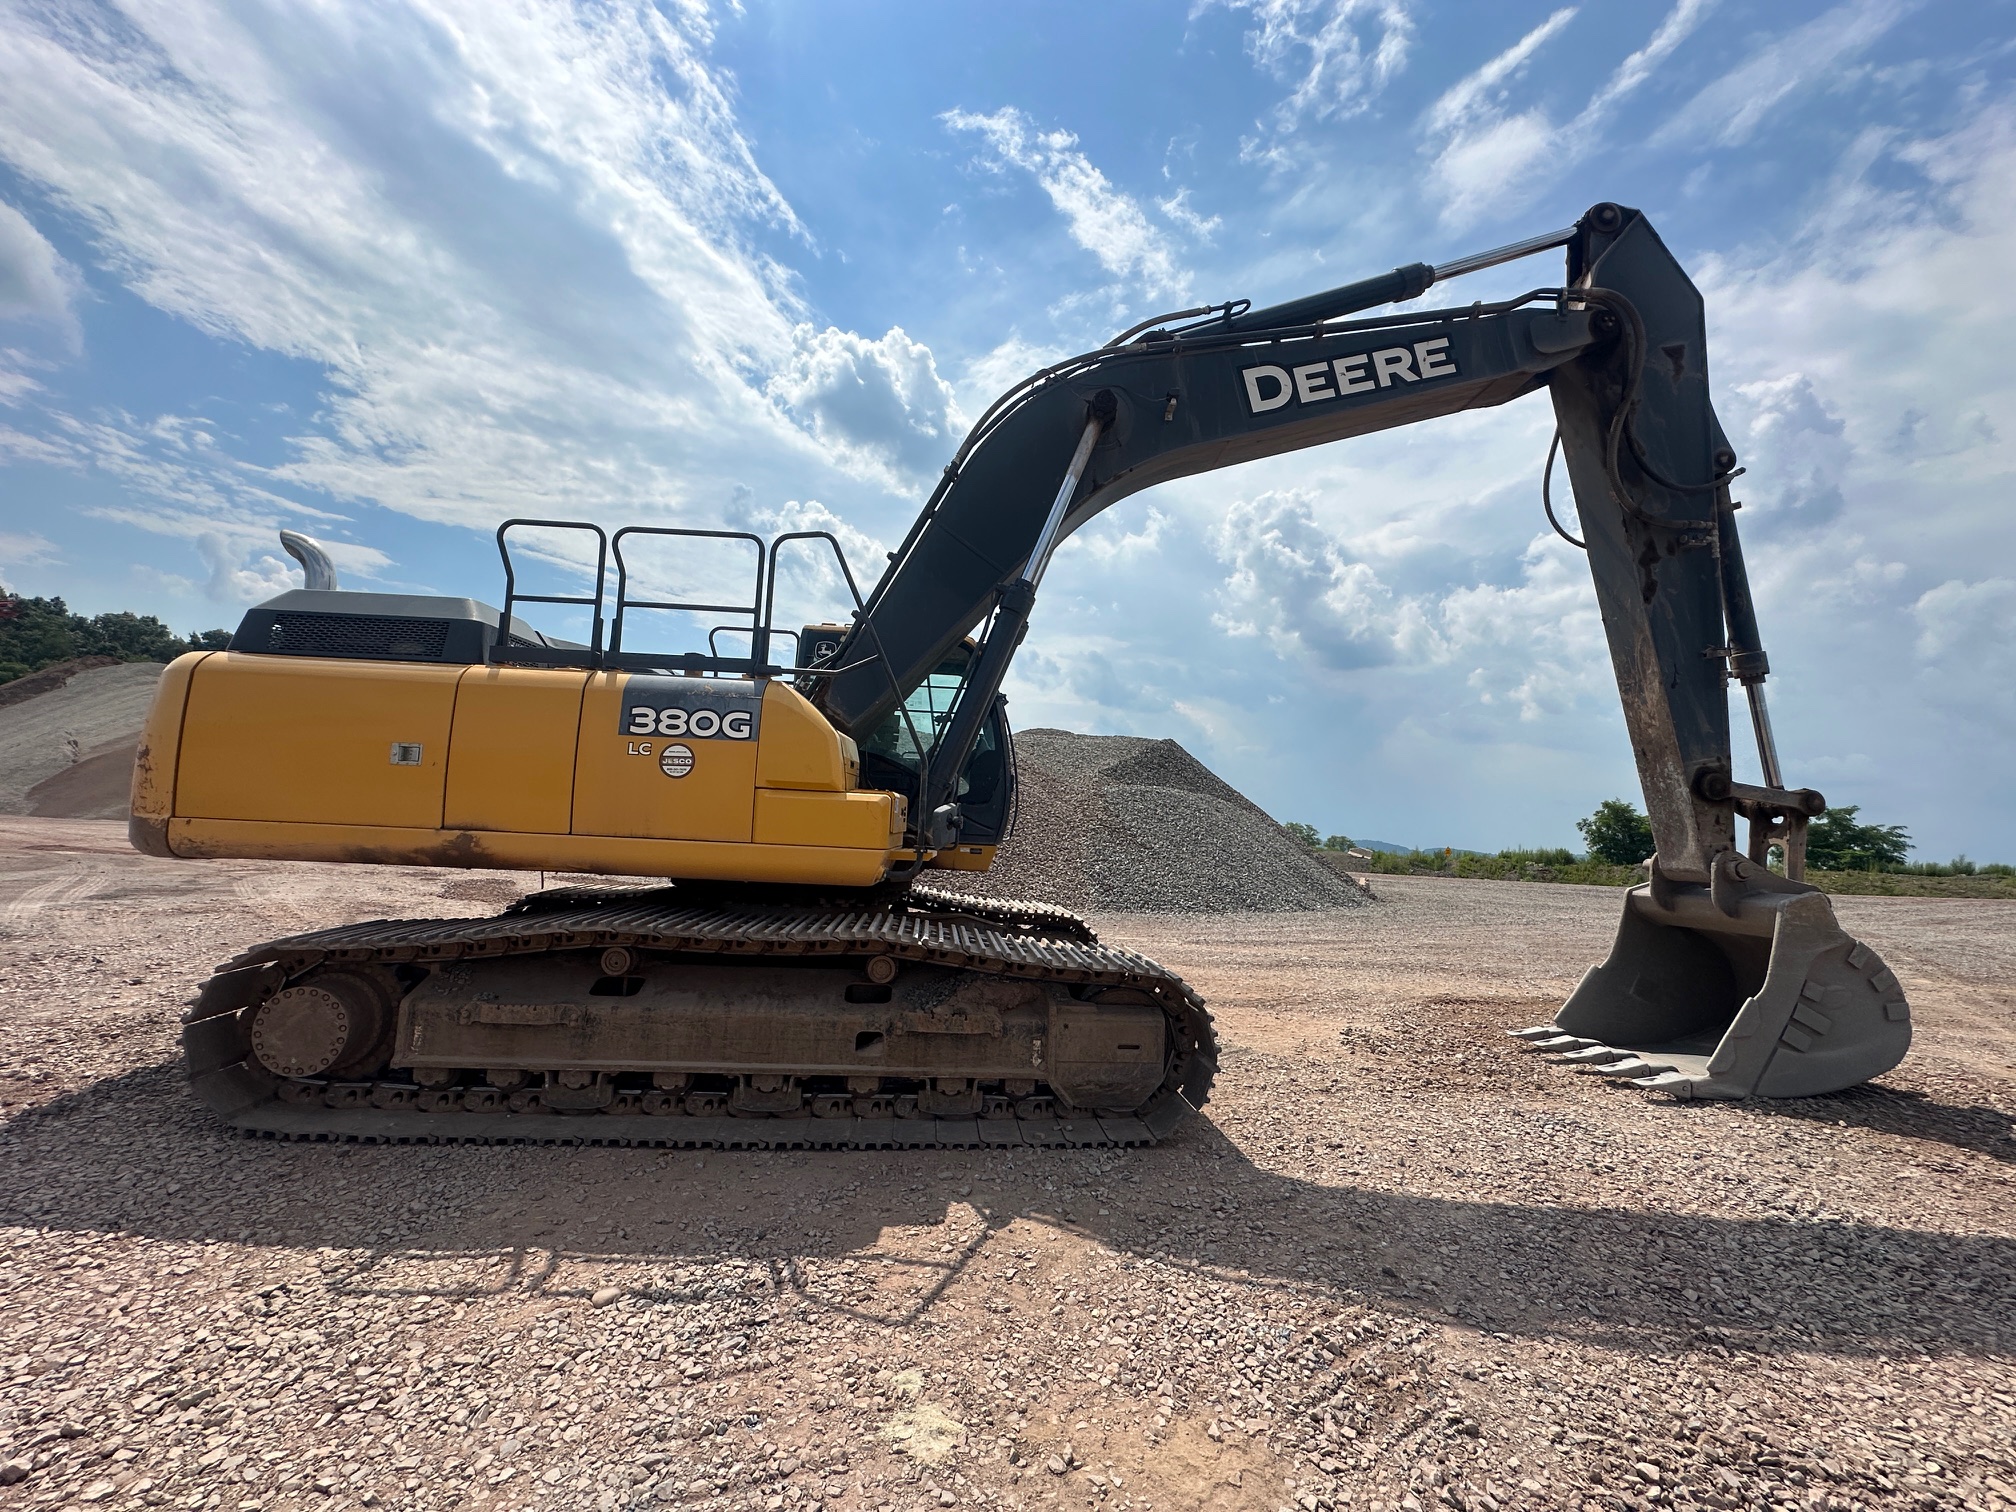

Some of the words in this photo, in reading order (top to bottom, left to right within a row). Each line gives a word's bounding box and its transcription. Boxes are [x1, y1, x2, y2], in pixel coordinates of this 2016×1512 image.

[1242, 337, 1457, 413] DEERE
[629, 706, 751, 739] 380G
[628, 742, 651, 755] LC
